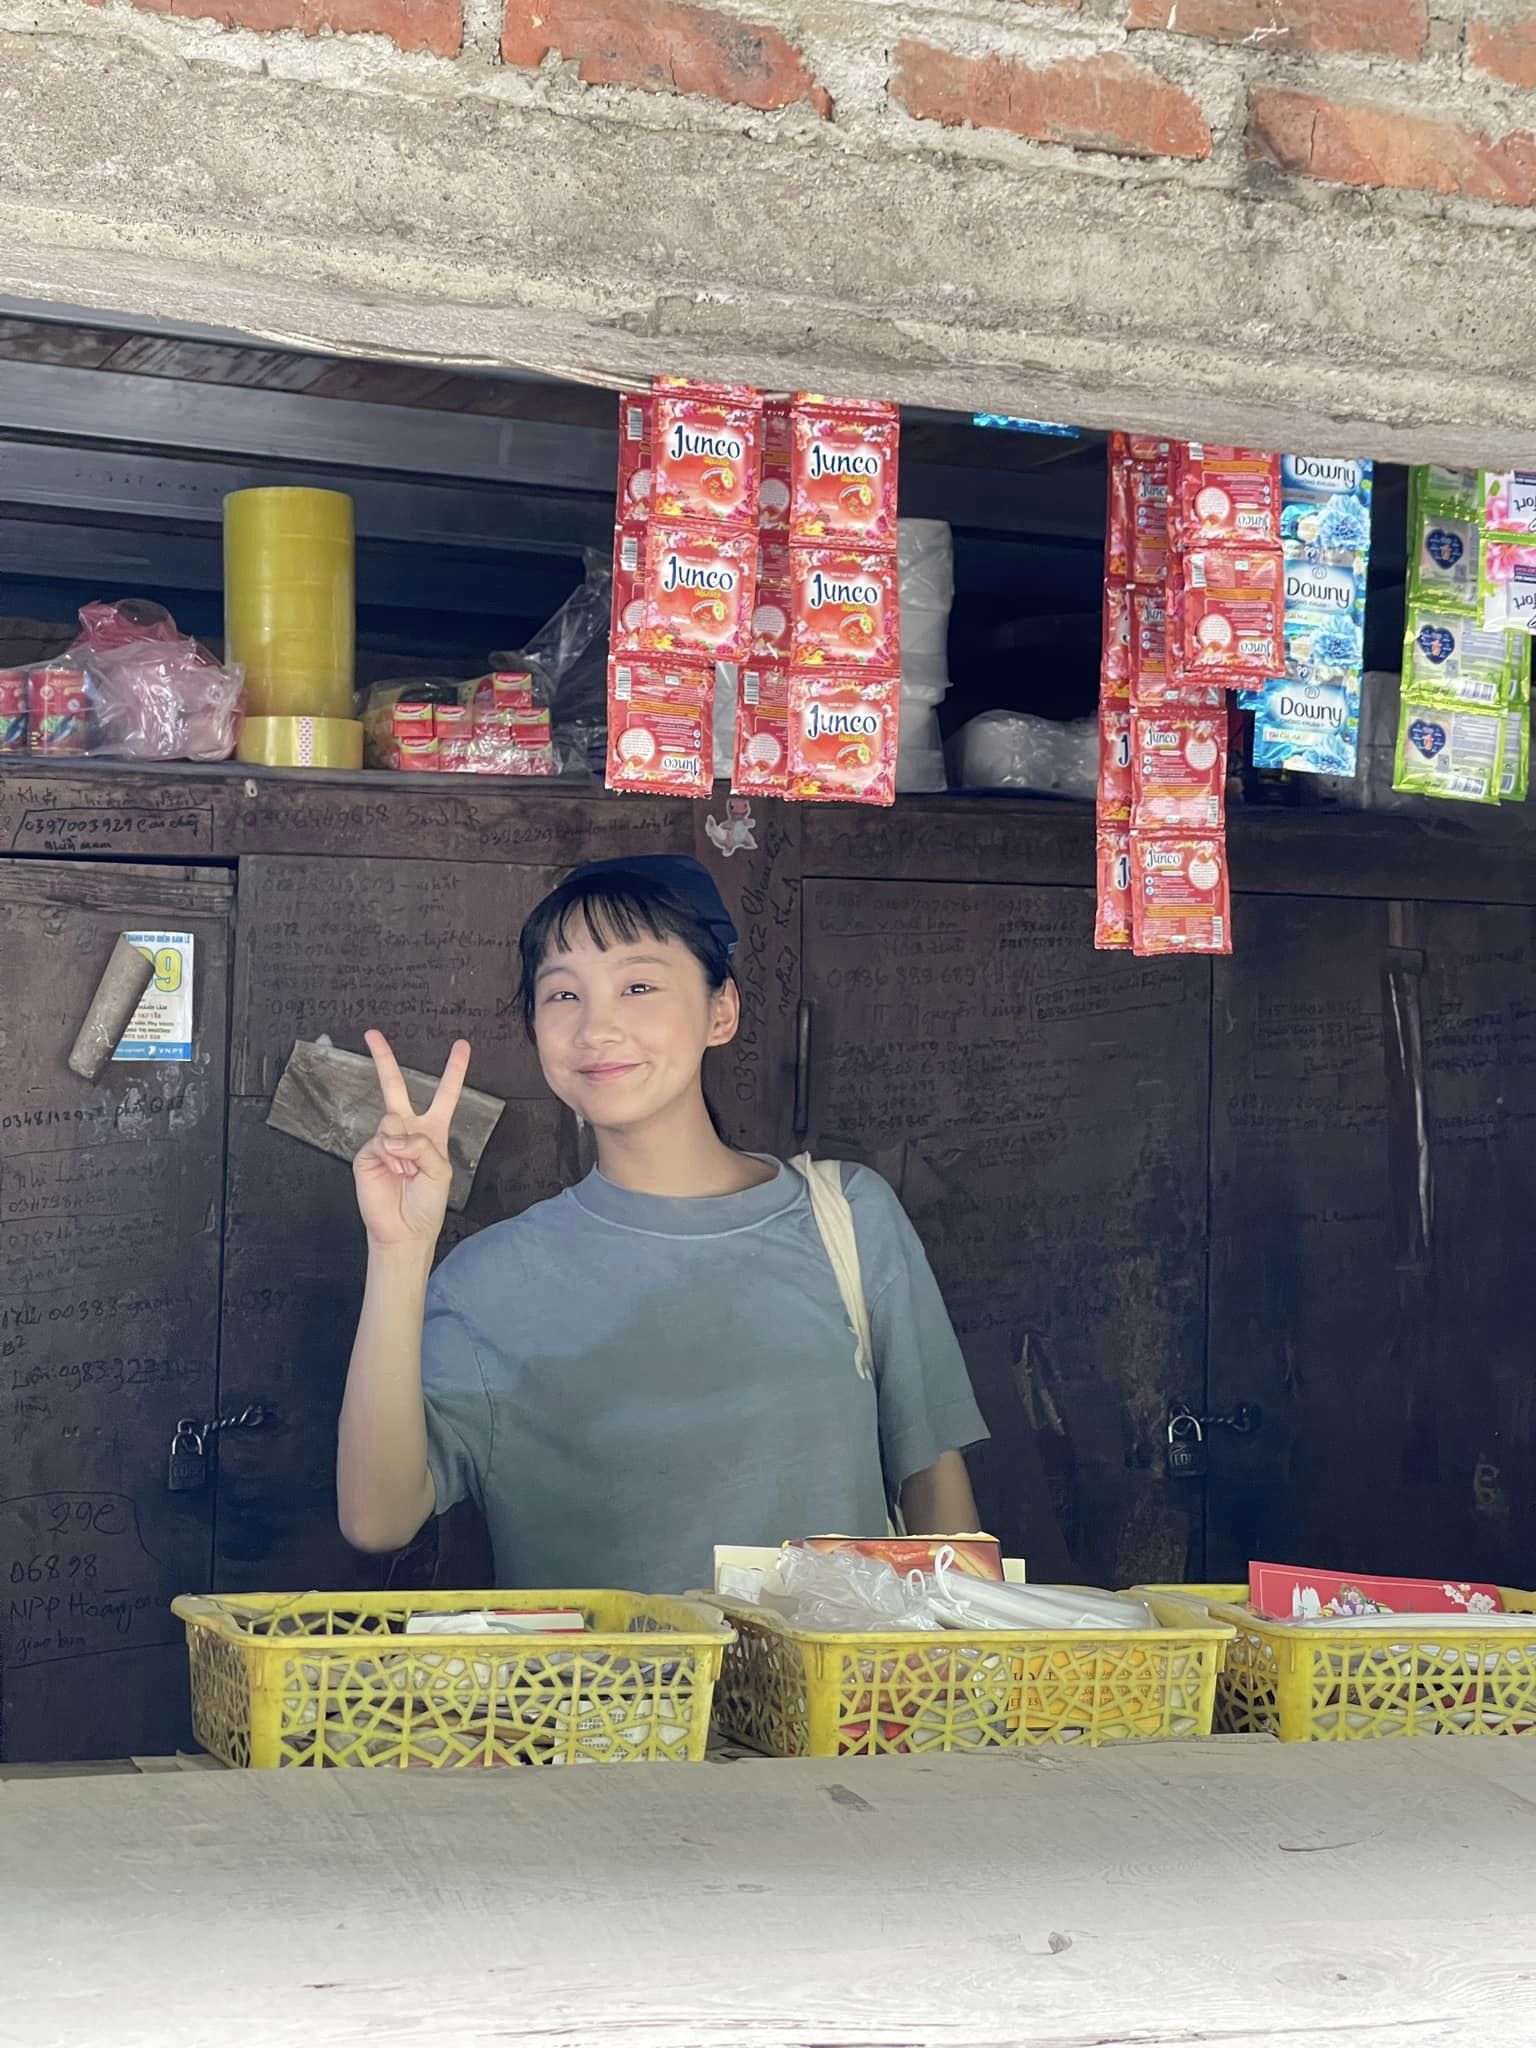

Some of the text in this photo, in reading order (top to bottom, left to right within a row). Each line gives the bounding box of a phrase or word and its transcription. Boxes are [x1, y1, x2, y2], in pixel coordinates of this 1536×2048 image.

[671, 425, 740, 459] Junco
[811, 445, 879, 477] Junco
[1295, 457, 1356, 489] Downy
[664, 556, 734, 591] Junco
[811, 574, 879, 607] Junco
[1287, 577, 1351, 609] Downy
[808, 704, 877, 738] Junco
[1280, 696, 1343, 728] Downy
[1146, 729, 1177, 746] Junco
[664, 757, 700, 776] Junco
[1146, 849, 1182, 867] Junco
